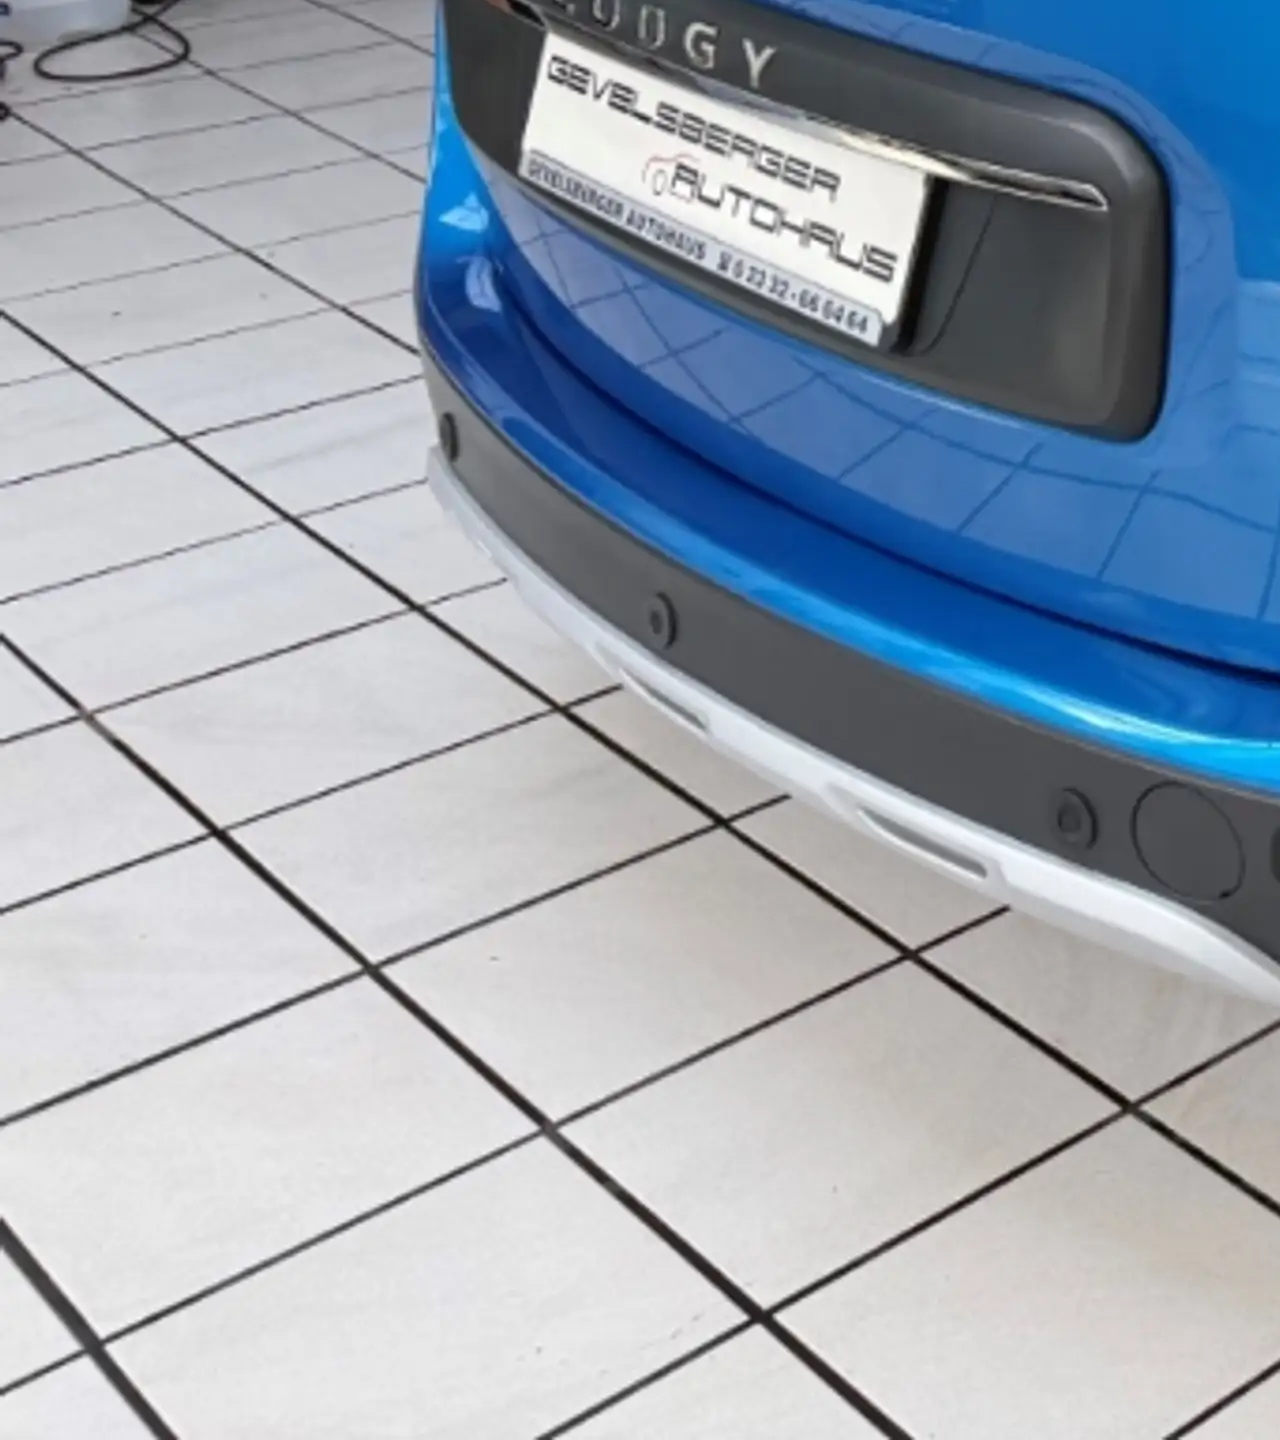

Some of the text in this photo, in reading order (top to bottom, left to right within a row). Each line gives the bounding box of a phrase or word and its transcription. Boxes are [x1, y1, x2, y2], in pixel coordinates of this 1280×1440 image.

[546, 54, 842, 203] GEVELSBERGER
[626, 208, 707, 261] AUTOHAUS
[670, 161, 899, 285] AUTOHAUS
